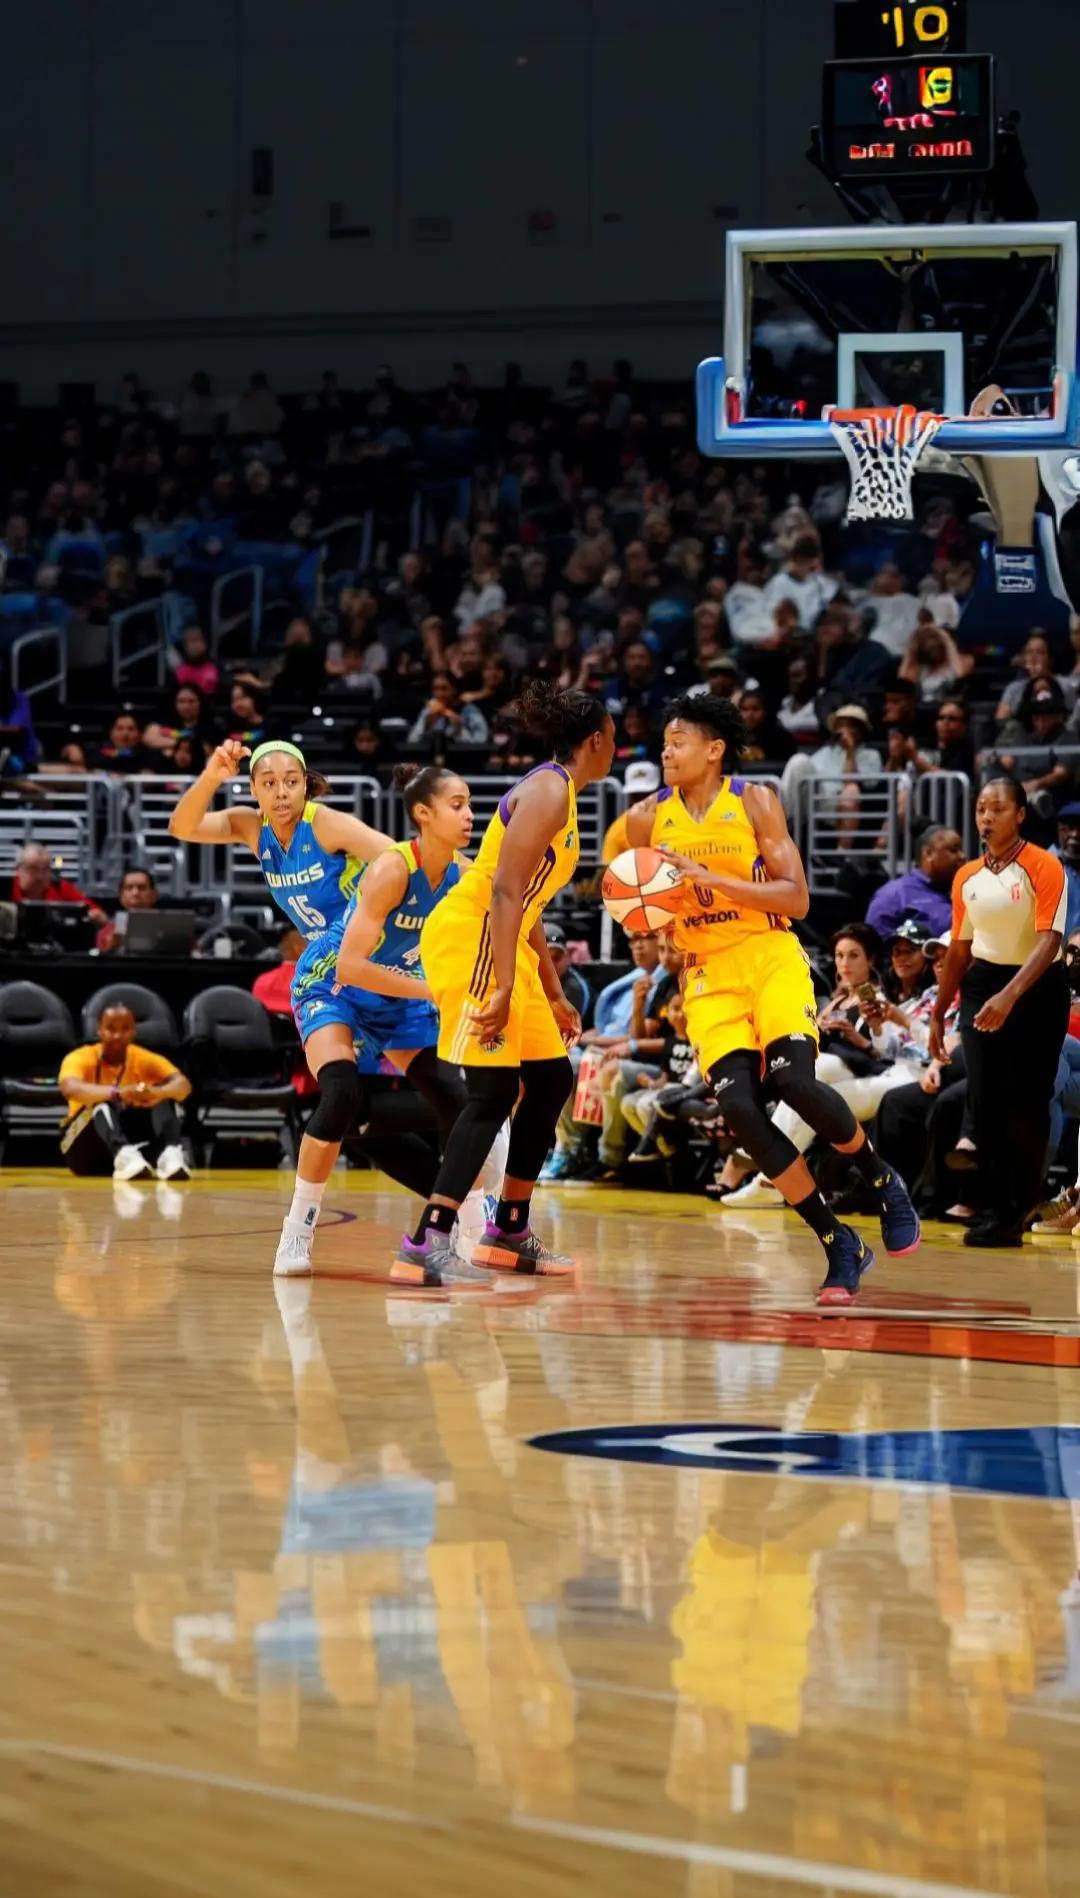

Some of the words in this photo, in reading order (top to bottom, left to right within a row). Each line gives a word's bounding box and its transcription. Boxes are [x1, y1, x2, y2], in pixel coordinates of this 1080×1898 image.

[265, 862, 325, 888] WINGS
[288, 895, 327, 928] 15
[683, 910, 739, 928] verizon
[402, 944, 421, 966] 4
